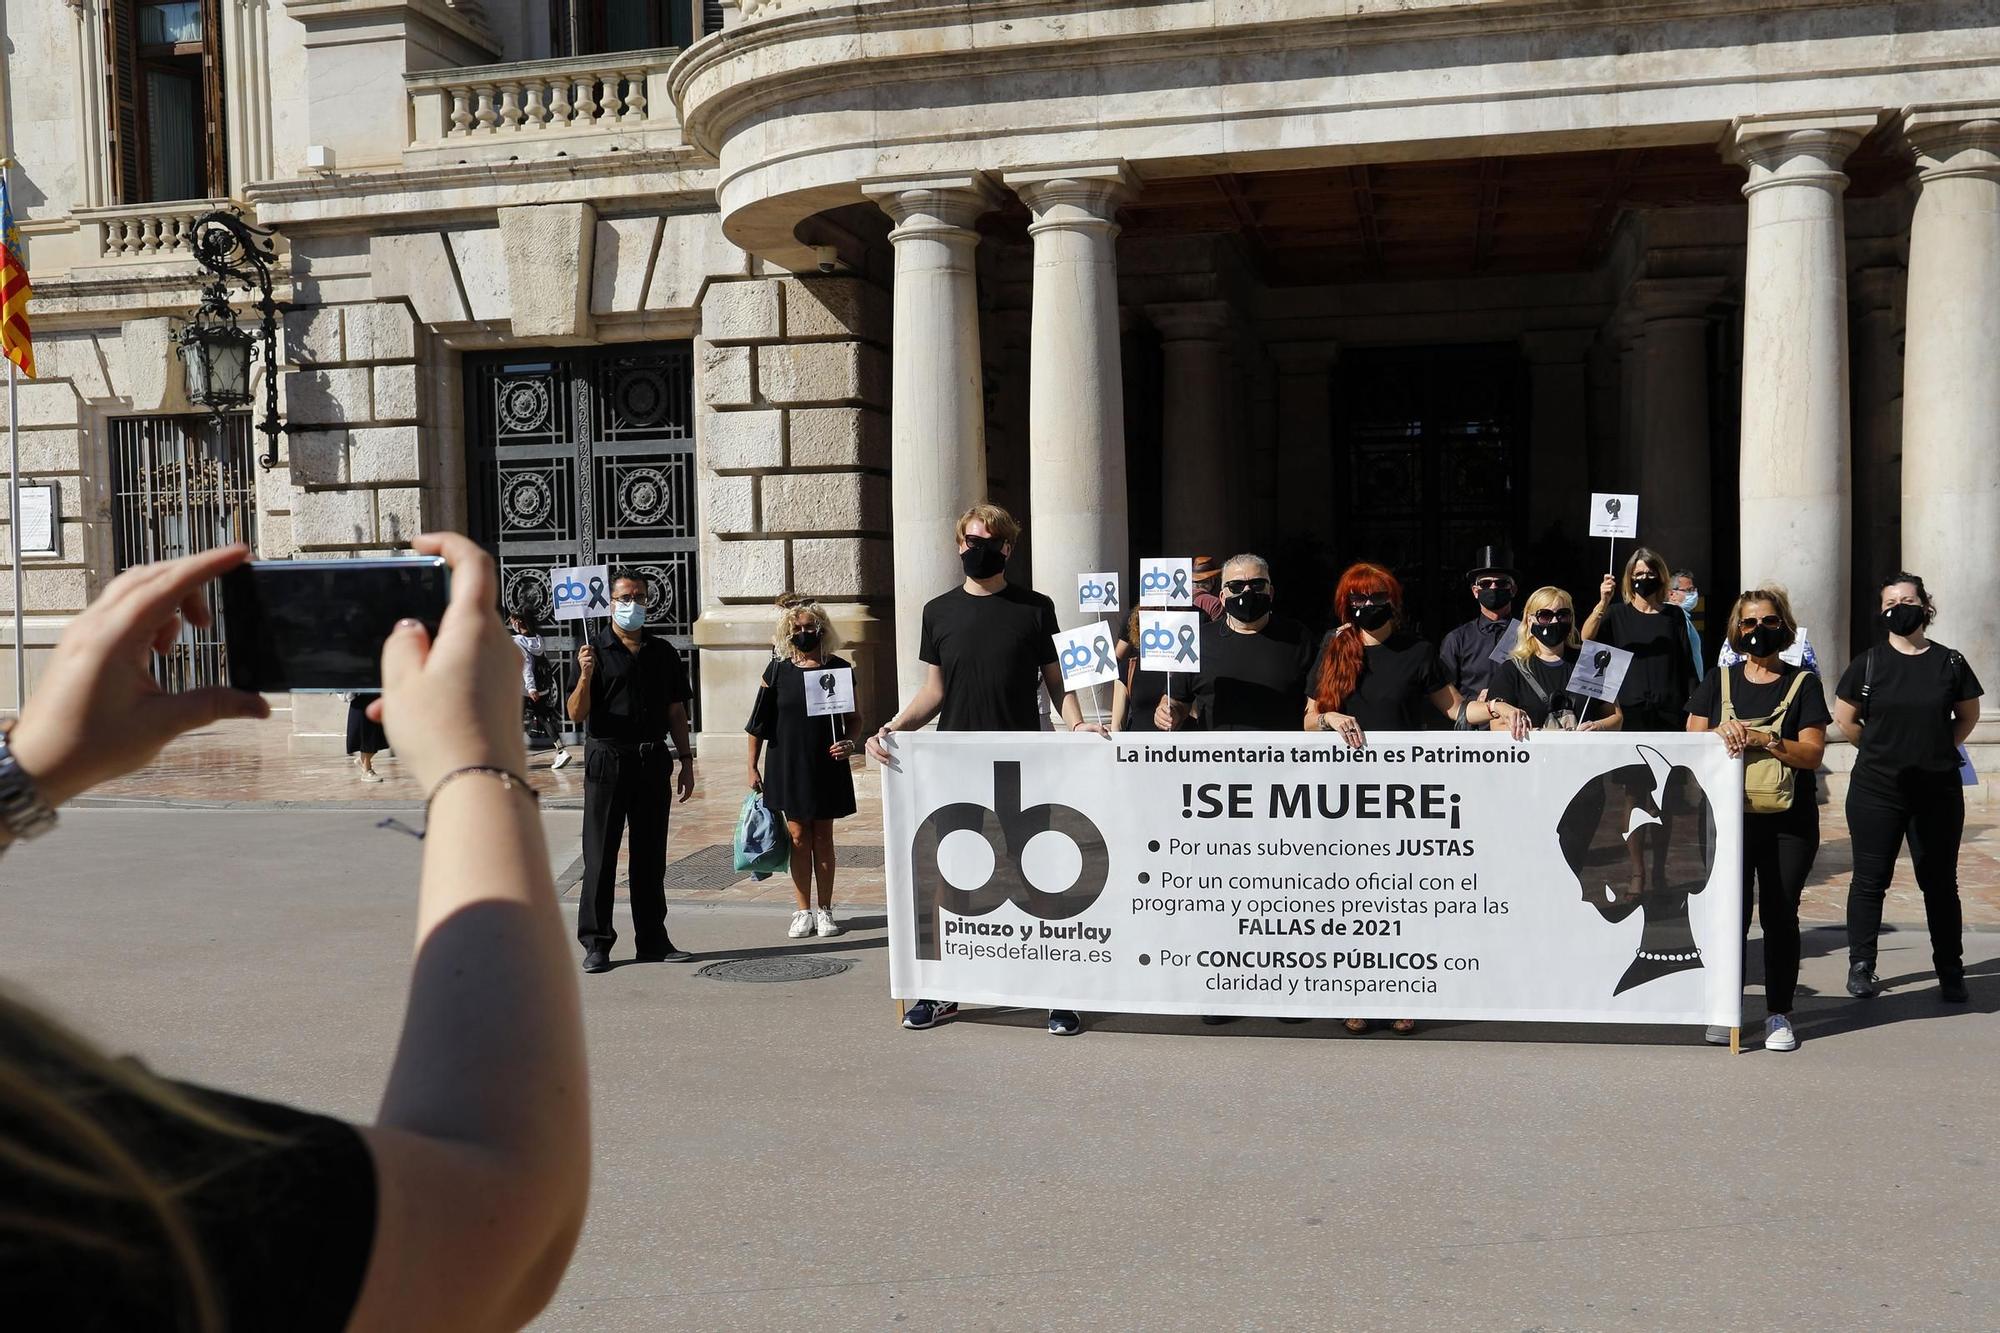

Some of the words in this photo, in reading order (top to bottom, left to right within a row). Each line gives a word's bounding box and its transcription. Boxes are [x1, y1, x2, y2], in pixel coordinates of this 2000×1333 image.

[1117, 746, 1138, 762] La
[1145, 745, 1284, 762] indumentaria
[1290, 745, 1377, 762] también
[1384, 750, 1405, 762] es
[1412, 746, 1530, 763] Patrimonio
[1182, 784, 1253, 818] !SE
[1269, 784, 1460, 829] MUERE¡
[1170, 839, 1200, 855] Por
[1207, 843, 1251, 855] unas
[1258, 838, 1390, 856] subvenciones
[1396, 840, 1474, 856] JUSTAS
[1162, 872, 1192, 888] Por
[1199, 877, 1222, 888] un
[1229, 872, 1349, 889] comunicado
[1356, 872, 1412, 890] oficial
[1420, 878, 1454, 890] con
[1461, 872, 1478, 890] el
[1133, 898, 1224, 915] programa
[1231, 900, 1241, 917] y
[1248, 896, 1335, 916] opciones
[1342, 897, 1427, 917] previstas
[1435, 901, 1476, 918] para
[1484, 896, 1508, 914] las
[945, 917, 1013, 941] pinazo
[1020, 926, 1032, 941] y
[1040, 921, 1111, 944] burlay
[1239, 919, 1315, 935] FALLAS
[1321, 918, 1346, 935] de
[1353, 919, 1401, 936] 2021
[945, 940, 1111, 962] trajesdefallera.es
[1161, 950, 1191, 966] Por
[1197, 951, 1327, 968] CONCURSOS
[1334, 949, 1437, 970] PÚBLICOS
[1444, 958, 1479, 970] con
[1206, 973, 1281, 991] claridad
[1289, 979, 1298, 995] y
[1304, 977, 1436, 996] transparencia
